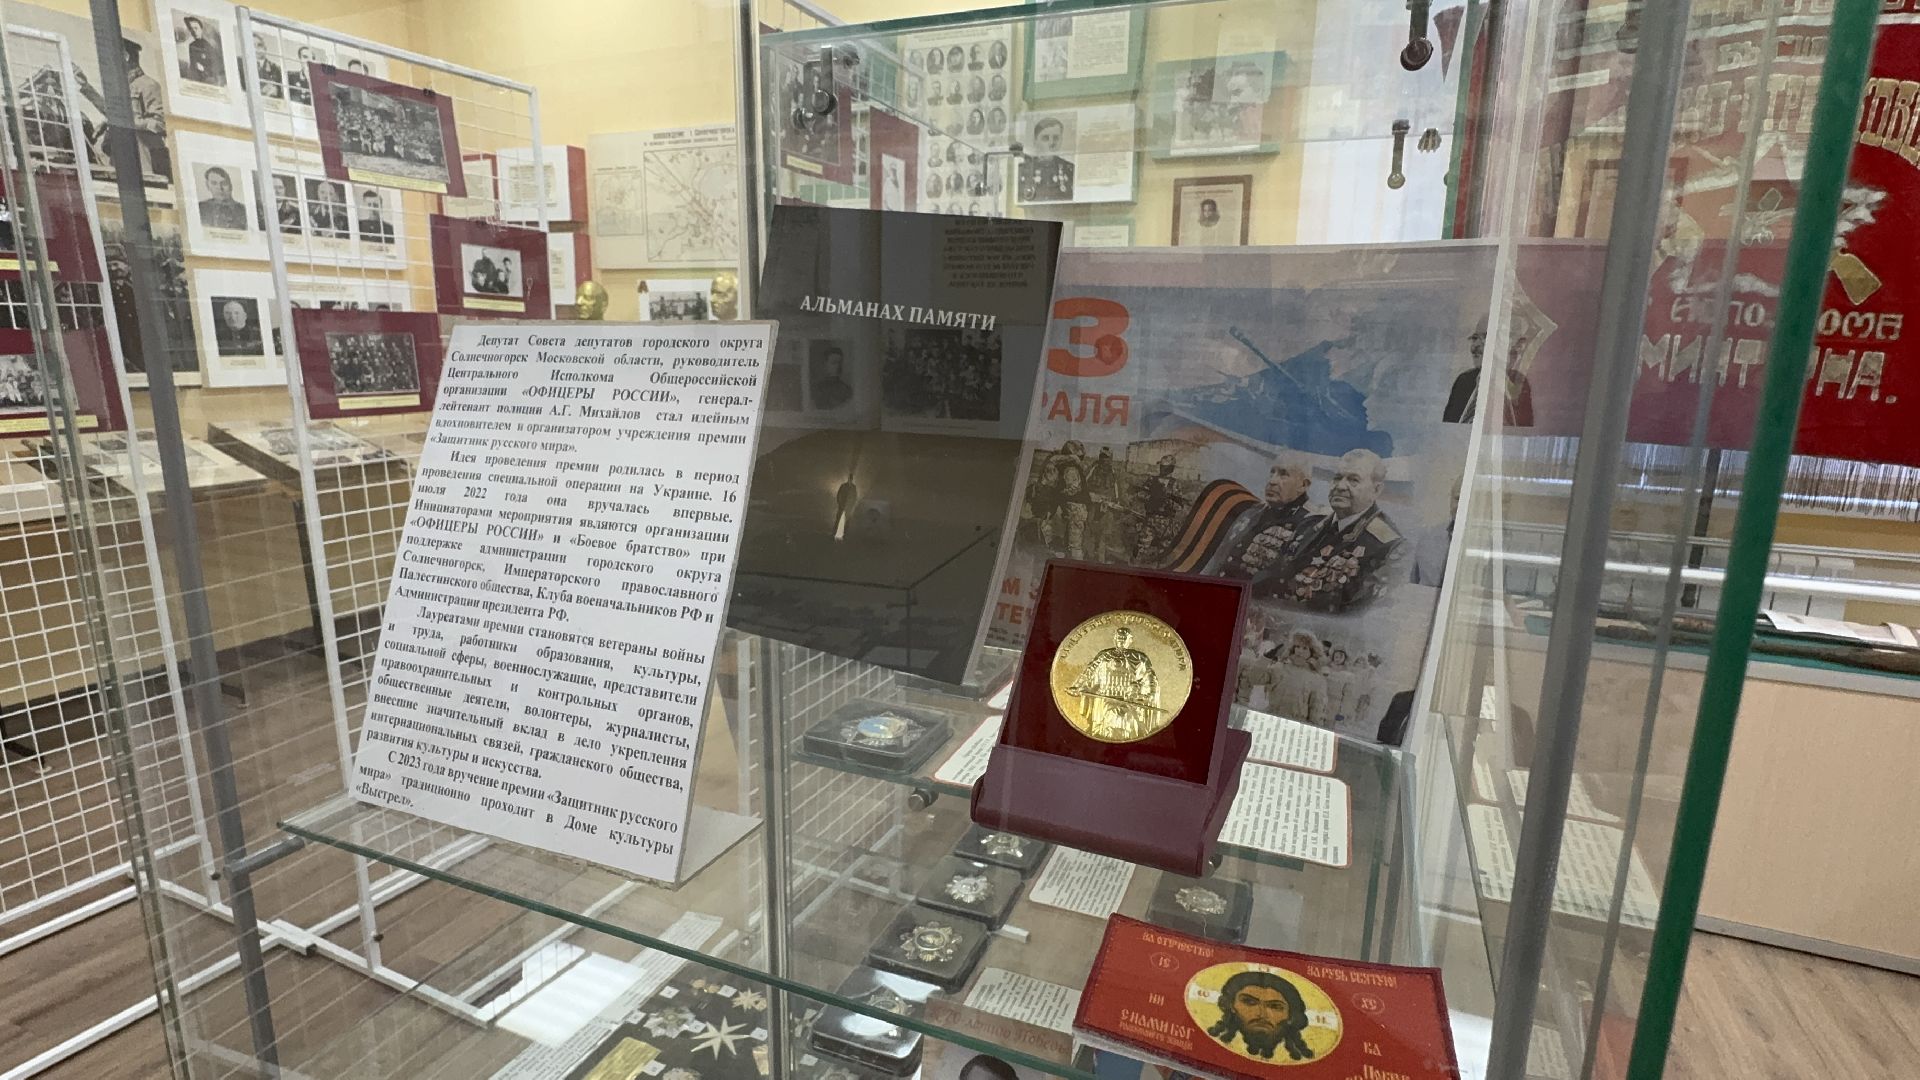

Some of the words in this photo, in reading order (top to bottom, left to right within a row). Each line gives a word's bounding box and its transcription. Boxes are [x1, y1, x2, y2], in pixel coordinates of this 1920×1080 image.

[800, 295, 905, 321] АЛЬМАНАХ
[909, 306, 997, 332] ПАМЯТИ
[451, 351, 529, 365] Солнечногорск
[536, 352, 605, 364] Московской
[613, 353, 664, 368] области,
[672, 357, 760, 369] руководитель
[477, 335, 519, 348] Депутат
[527, 335, 566, 347] Совета
[574, 338, 633, 350] депутатов
[642, 338, 710, 351] городского
[720, 339, 763, 352] округа
[443, 386, 508, 397] организации
[522, 386, 596, 400] «ОФИЦЕРЫ
[612, 388, 680, 405] РОССИИ»,
[698, 395, 753, 408] генерал-
[447, 367, 519, 381] Центрального
[550, 369, 615, 383] Исполкома
[649, 372, 758, 387] Общероссийской
[438, 401, 491, 412] лейтенант
[496, 405, 543, 415] полиции
[548, 404, 572, 416] А.Г.
[579, 405, 641, 420] Михайлов
[655, 412, 683, 422] стал
[691, 412, 750, 425] идейным
[1042, 391, 1130, 426] АЛЯ
[430, 433, 489, 446] «Защитник
[490, 439, 538, 450] русского
[540, 442, 577, 454] мира».
[435, 419, 512, 430] вдохновителем
[517, 423, 524, 431] и
[526, 424, 611, 438] организатором
[616, 429, 691, 441] учреждения
[697, 433, 747, 445] премии
[421, 468, 482, 480] проведения
[487, 474, 558, 487] специальной
[565, 480, 622, 493] операции
[629, 485, 644, 495] на
[653, 484, 712, 501] Украине.
[722, 489, 737, 503] 16
[450, 450, 477, 463] Идея
[484, 456, 547, 468] проведения
[555, 461, 600, 473] премии
[608, 465, 665, 477] родилась
[675, 469, 683, 479] в
[693, 472, 740, 485] период
[414, 499, 493, 518] Инициаторами
[498, 511, 573, 526] мероприятия
[579, 518, 638, 533] являются
[645, 525, 730, 543] организации
[417, 485, 447, 495] июля
[463, 486, 488, 499] 2022
[504, 492, 528, 503] года
[546, 496, 567, 507] она
[587, 500, 650, 514] вручалась
[672, 508, 733, 523] впервые.
[406, 536, 463, 550] поддержке
[479, 545, 567, 563] администрации
[586, 557, 654, 574] городского
[676, 568, 722, 584] округа
[409, 517, 479, 534] «ОФИЦЕРЫ
[485, 524, 544, 541] РОССИИ»
[553, 534, 561, 544] и
[569, 533, 617, 550] «Боевое
[625, 539, 690, 558] братство»
[700, 551, 726, 564] при
[394, 586, 481, 608] Администрации
[482, 601, 545, 618] президента
[547, 606, 569, 622] РФ.
[398, 568, 478, 589] Палестинского
[480, 579, 533, 600] общества,
[535, 586, 573, 604] Клуба
[575, 595, 678, 617] военачальников
[680, 605, 703, 621] РФ
[704, 610, 714, 624] и
[503, 563, 601, 587] Императорского
[621, 582, 720, 603] православного
[387, 622, 396, 632] и
[412, 626, 444, 641] труда,
[459, 634, 518, 653] работники
[633, 664, 701, 687] культуры,
[416, 607, 481, 627] Лауреатами
[483, 620, 525, 635] премии
[528, 627, 595, 647] становятся
[598, 639, 658, 657] ветераны
[660, 648, 705, 665] войны
[381, 658, 493, 687] правоохранительных
[510, 683, 519, 693] и
[537, 688, 619, 712] контрольных
[637, 707, 694, 729] органов,
[384, 640, 447, 659] социальной
[451, 651, 487, 669] сферы,
[603, 680, 698, 706] представители
[373, 694, 419, 710] внесшие
[426, 705, 504, 729] значительный
[512, 723, 549, 740] вклад
[557, 732, 565, 742] в
[573, 737, 602, 750] дело
[609, 743, 688, 769] укрепления
[377, 674, 453, 698] общественные
[462, 693, 510, 713] деятели,
[524, 706, 592, 729] волонтеры,
[605, 722, 690, 750] журналисты,
[366, 729, 414, 748] развития
[415, 741, 470, 762] культуры
[471, 754, 480, 764] и
[481, 756, 542, 778] искусства.
[370, 712, 478, 743] интернациональных
[483, 737, 524, 756] связей,
[529, 747, 614, 774] гражданского
[619, 765, 683, 793] общества,
[359, 766, 392, 781] мира»
[401, 776, 471, 801] традиционно
[480, 797, 536, 818] проходит
[545, 813, 554, 824] в
[563, 814, 599, 835] Доме
[609, 830, 674, 855] культуры
[387, 750, 397, 763] С
[397, 752, 422, 769] 2023
[422, 762, 446, 776] года
[447, 768, 500, 788] вручение
[500, 781, 545, 800] премии
[546, 790, 619, 818] «Защитник
[619, 810, 678, 833] русского
